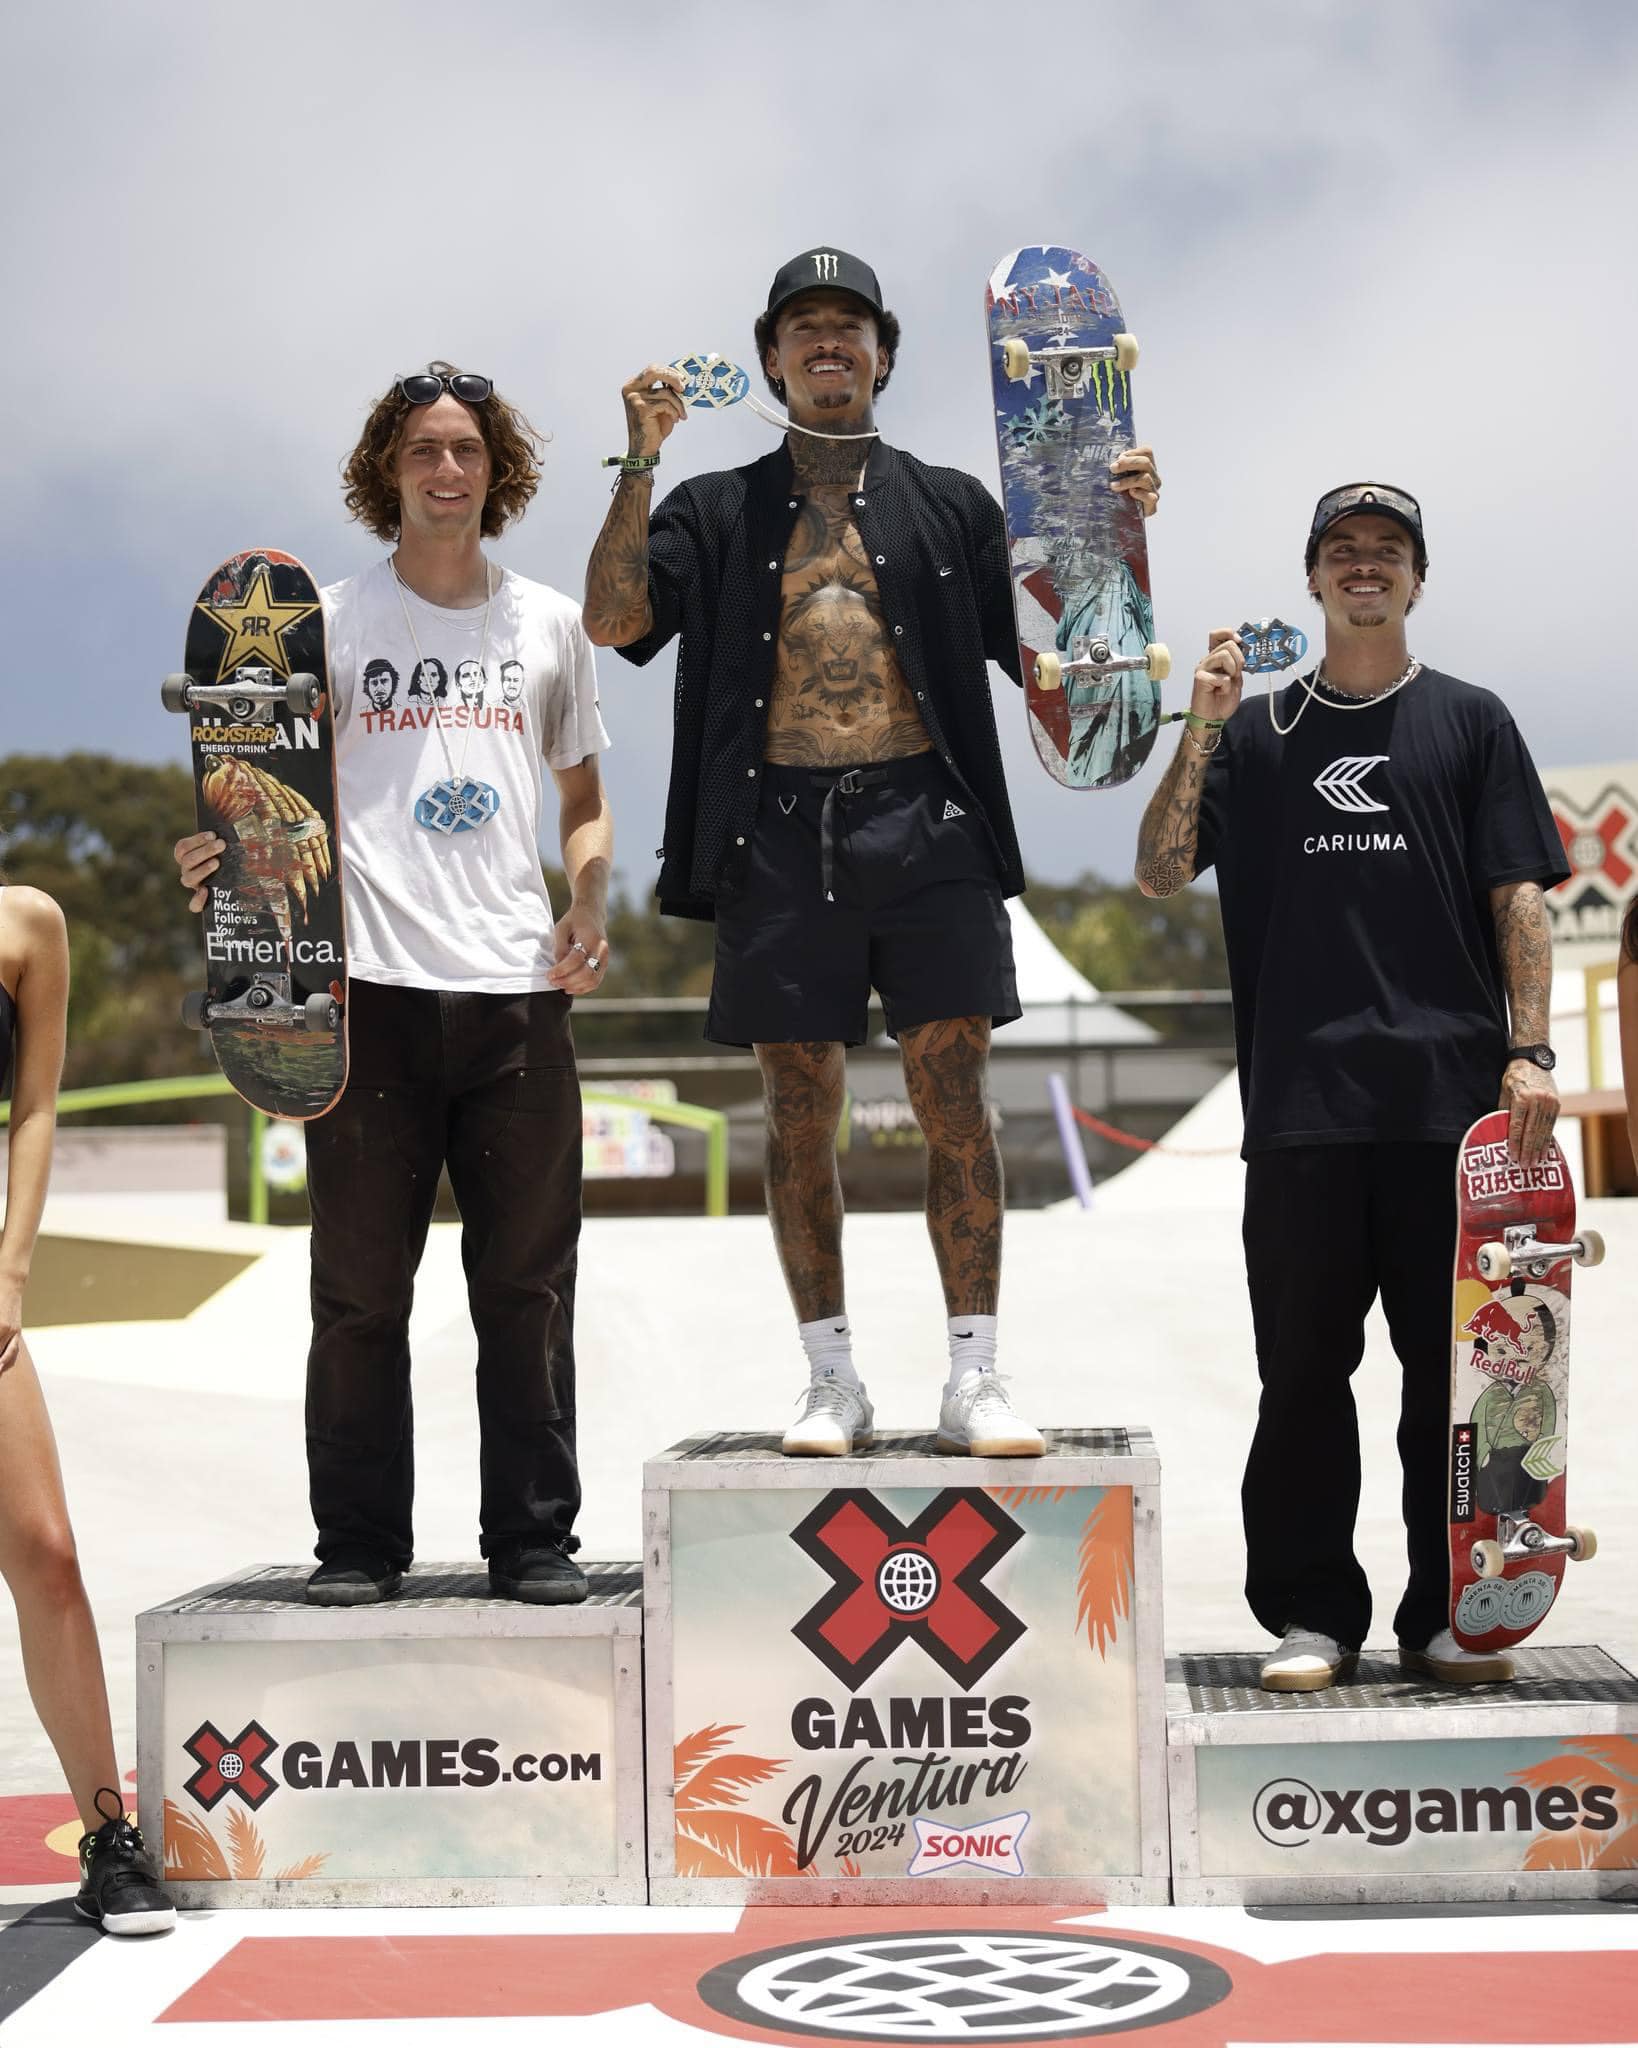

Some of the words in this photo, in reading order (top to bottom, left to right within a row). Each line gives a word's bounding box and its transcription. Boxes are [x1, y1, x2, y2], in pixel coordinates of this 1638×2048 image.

[192, 726, 277, 743] ROCKSTAR
[359, 706, 525, 736] TRAVESURA
[200, 744, 236, 753] ENERGY
[237, 744, 268, 753] DRINK
[1303, 833, 1409, 854] CARIUMA
[212, 886, 232, 901] Toy
[206, 931, 343, 963] Emerica.
[1469, 1165, 1562, 1199] RIBEIRO
[1469, 1349, 1504, 1375] Red
[1504, 1359, 1537, 1385] Bull
[1455, 1443, 1471, 1516] swatch
[790, 1695, 1033, 1751] GAMES
[781, 1751, 1030, 1872] Ventura
[1252, 1777, 1619, 1848] @xgames
[834, 1822, 906, 1858] 2024
[922, 1834, 1013, 1858] SONIC
